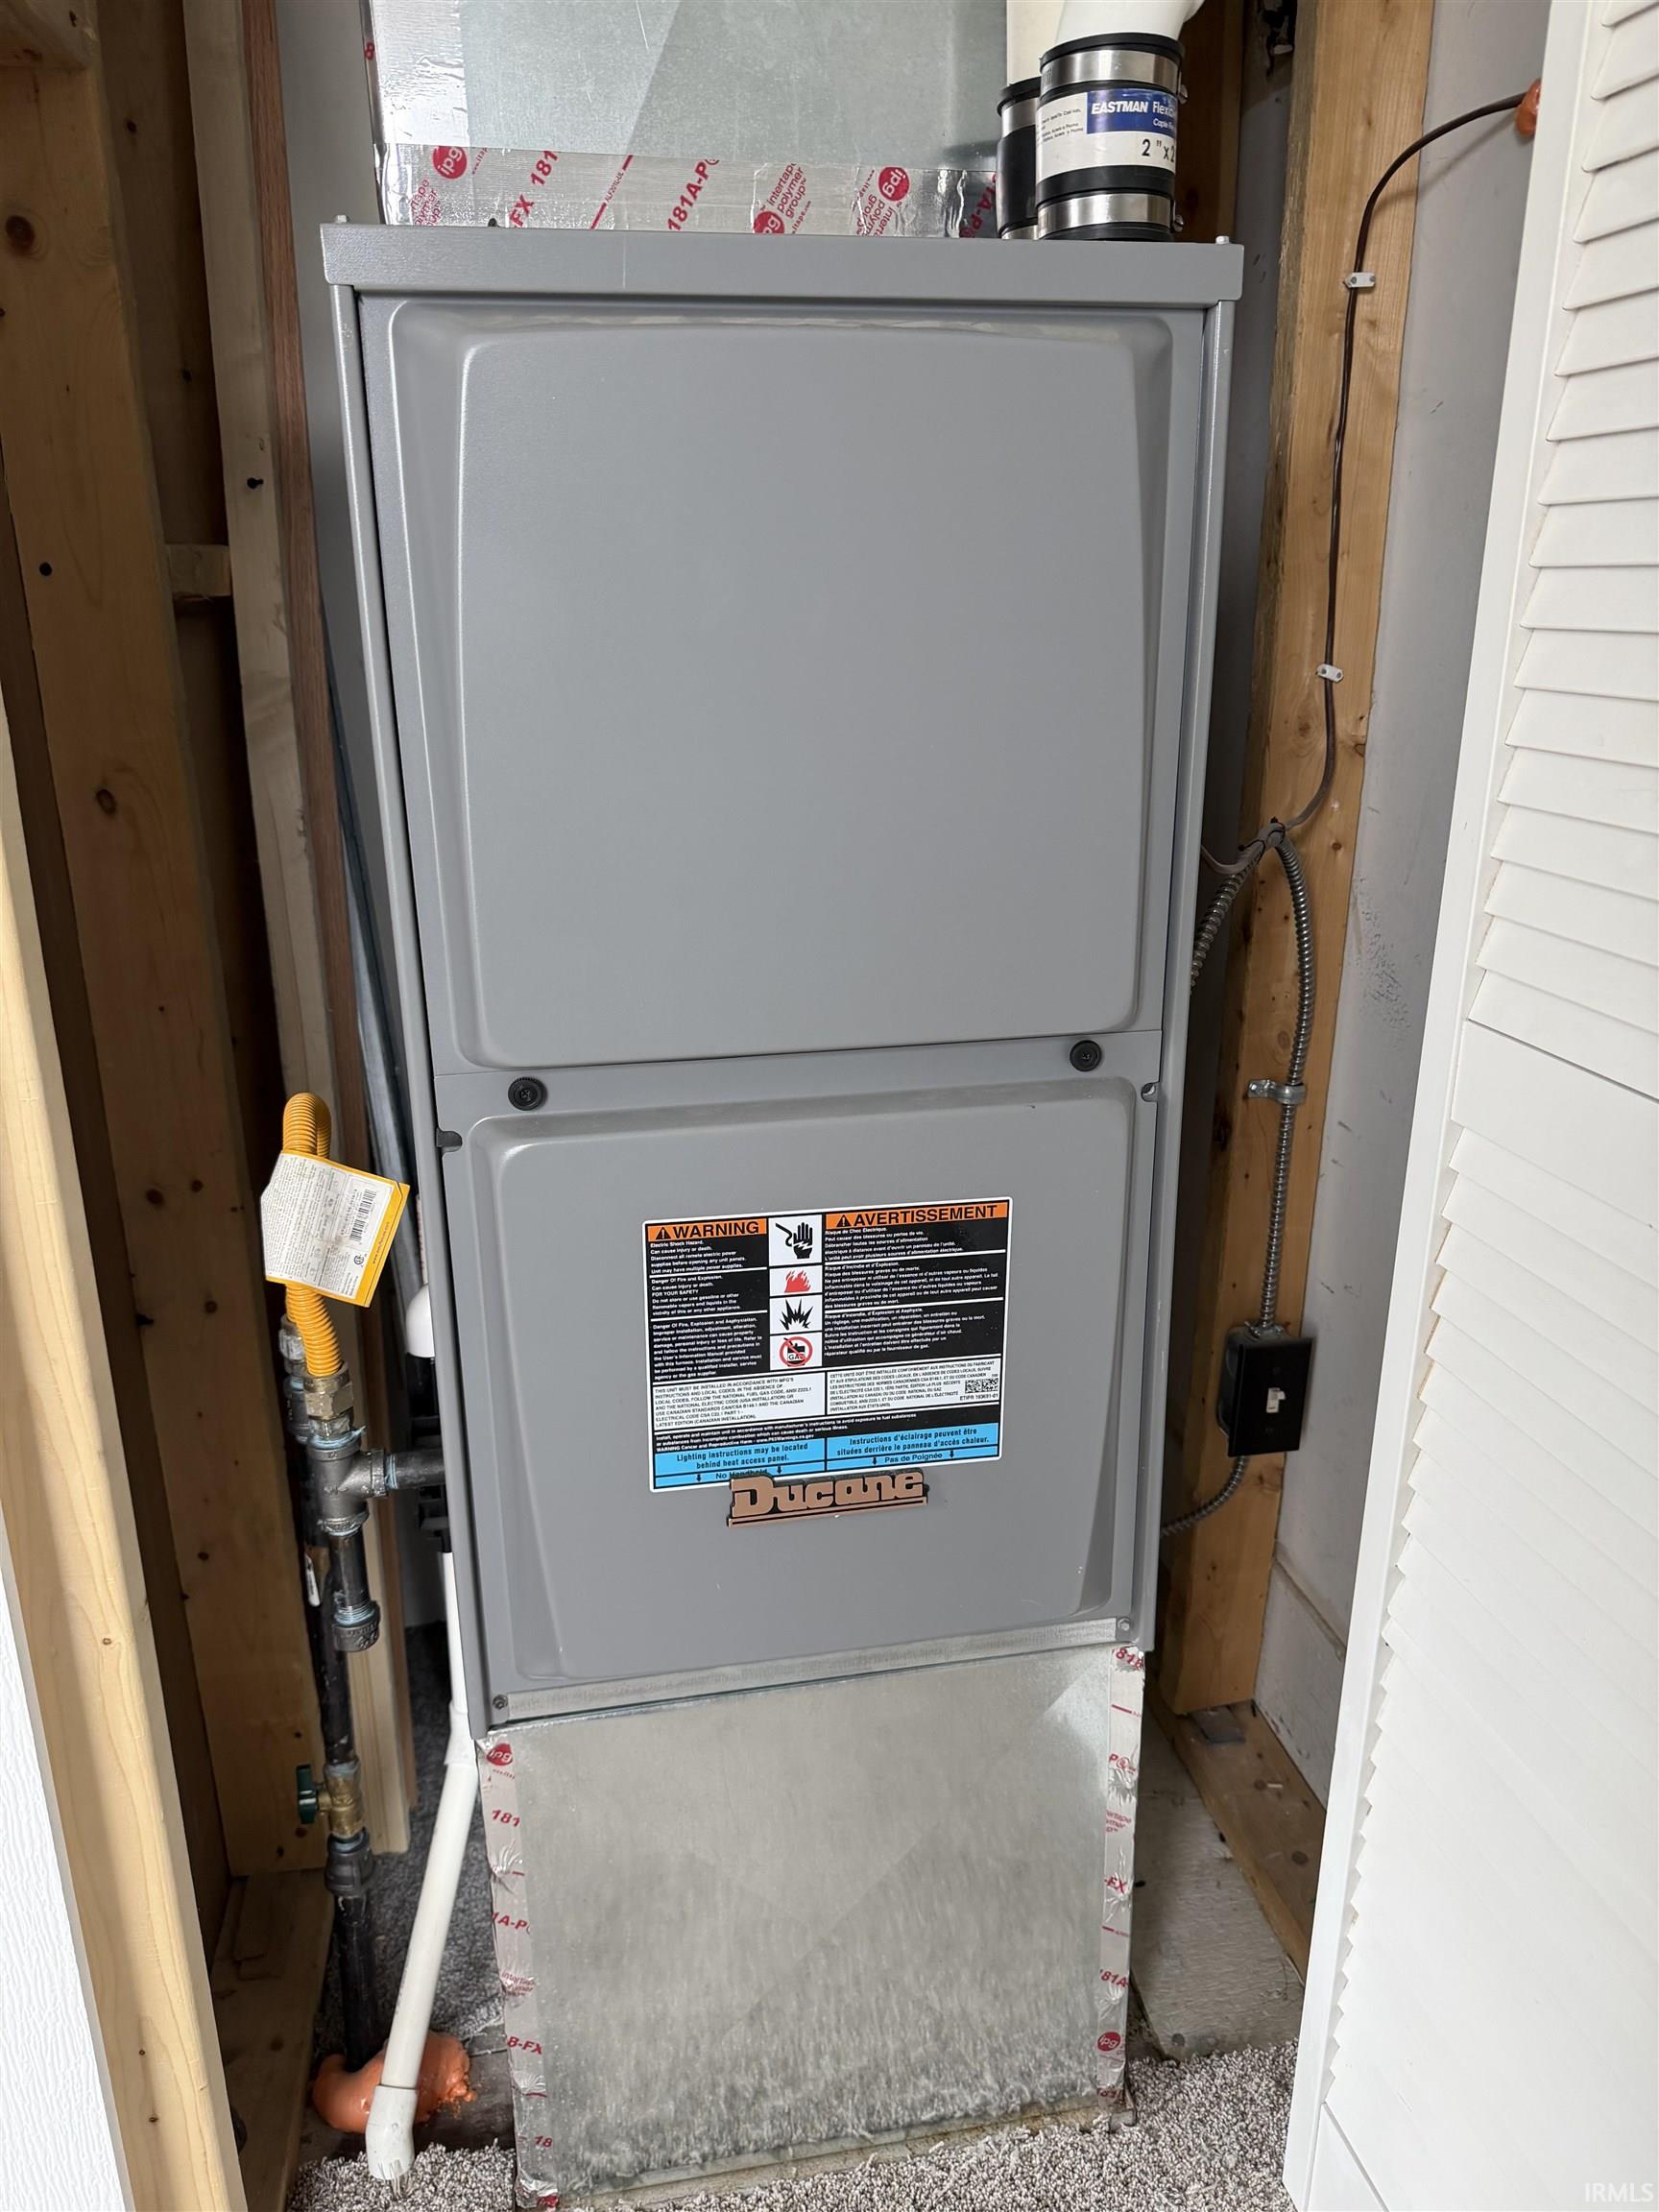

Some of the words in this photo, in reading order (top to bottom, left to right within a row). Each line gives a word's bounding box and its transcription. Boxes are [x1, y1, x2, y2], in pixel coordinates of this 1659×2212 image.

[1091, 101, 1149, 115] EASTMAN
[777, 167, 805, 213] polymer
[881, 169, 907, 198] ipg
[854, 1205, 996, 1226] AVERTISSEMENT
[673, 1221, 758, 1238] WARNING
[837, 1446, 861, 1455] situées
[864, 1443, 891, 1453] derrière
[902, 1442, 931, 1450] panneau
[934, 1438, 959, 1447] d'accès
[961, 1435, 988, 1444] chaleur.
[849, 1434, 891, 1445] Instructions
[893, 1431, 931, 1442] d'éclairage
[934, 1428, 961, 1438] peuvent
[963, 1427, 976, 1435] être
[676, 1451, 706, 1461] Lighting
[708, 1447, 751, 1457] instructions
[782, 1442, 807, 1451] located
[696, 1459, 720, 1468] behind
[723, 1458, 738, 1466] heat
[767, 1453, 788, 1463] panel.
[912, 1452, 942, 1461] Poignée
[731, 1471, 924, 1518] Ducane
[492, 1809, 521, 1828] 181
